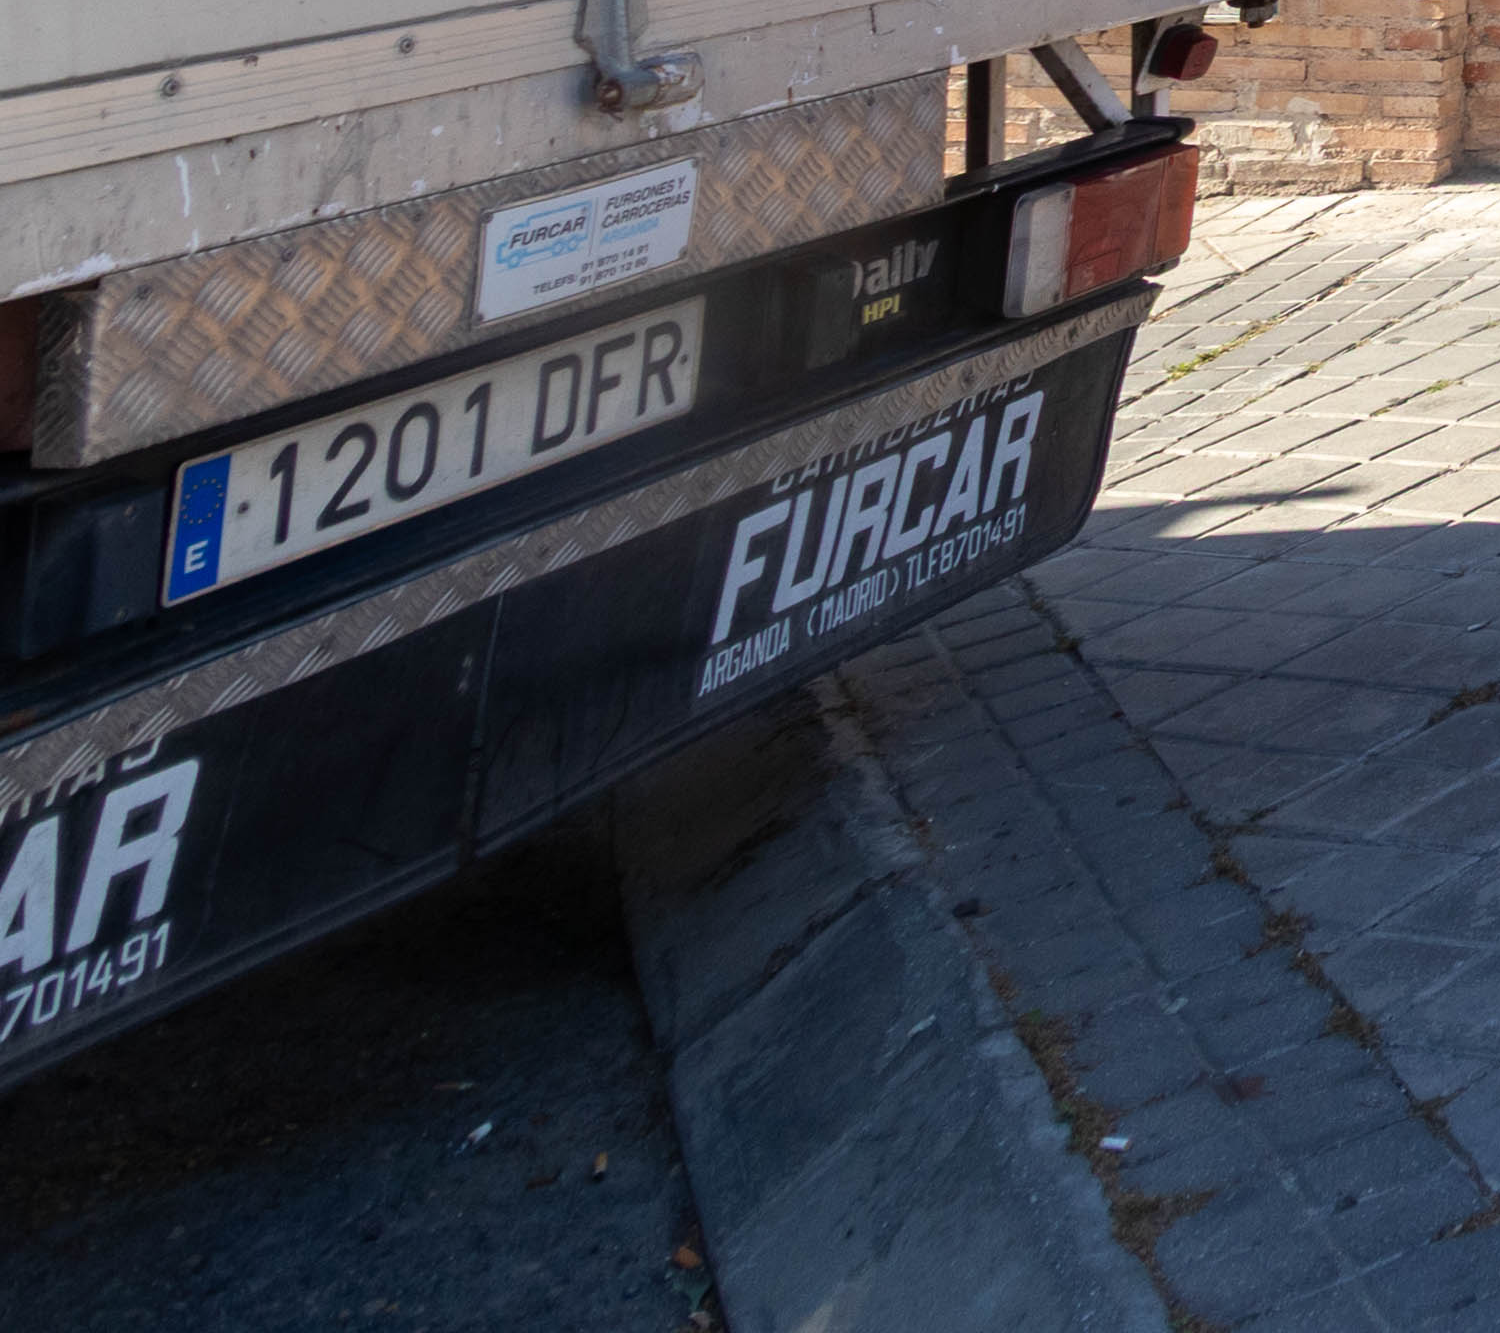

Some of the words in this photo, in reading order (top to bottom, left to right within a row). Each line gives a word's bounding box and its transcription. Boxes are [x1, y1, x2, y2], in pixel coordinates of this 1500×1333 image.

[601, 190, 691, 229] CARROCERIAS
[604, 179, 675, 211] FURGONES
[678, 175, 687, 190] Y
[508, 216, 587, 250] FURCAR
[861, 293, 901, 325] HPI
[269, 382, 493, 546] 1201
[530, 320, 683, 456] DFR
[711, 389, 1045, 646] FURCAR
[184, 539, 209, 575] E
[698, 616, 791, 698] ARGANDA
[807, 567, 899, 637] (MADRID)
